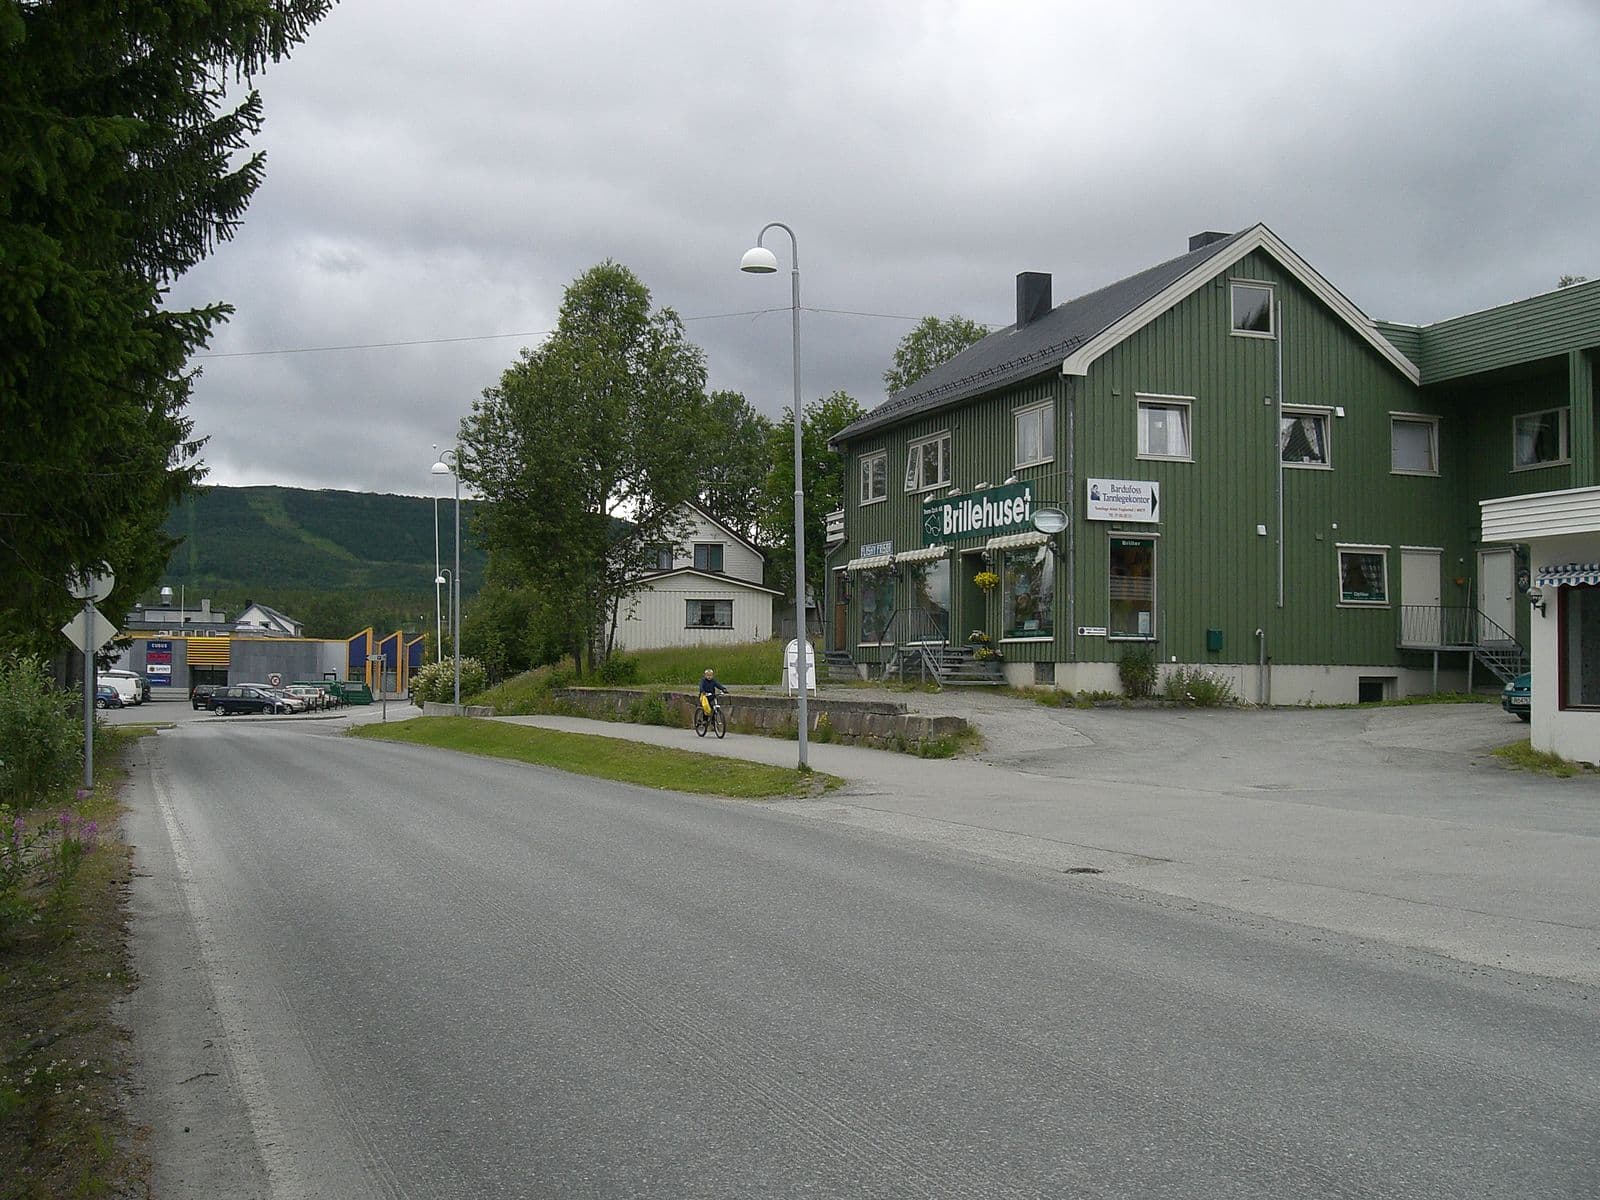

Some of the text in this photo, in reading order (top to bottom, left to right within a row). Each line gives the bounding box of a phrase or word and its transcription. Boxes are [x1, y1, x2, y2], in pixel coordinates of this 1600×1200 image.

[1110, 484, 1142, 494] Bardufoss
[1102, 492, 1150, 505] Tannlegekontor
[943, 487, 1031, 535] Brillehuset
